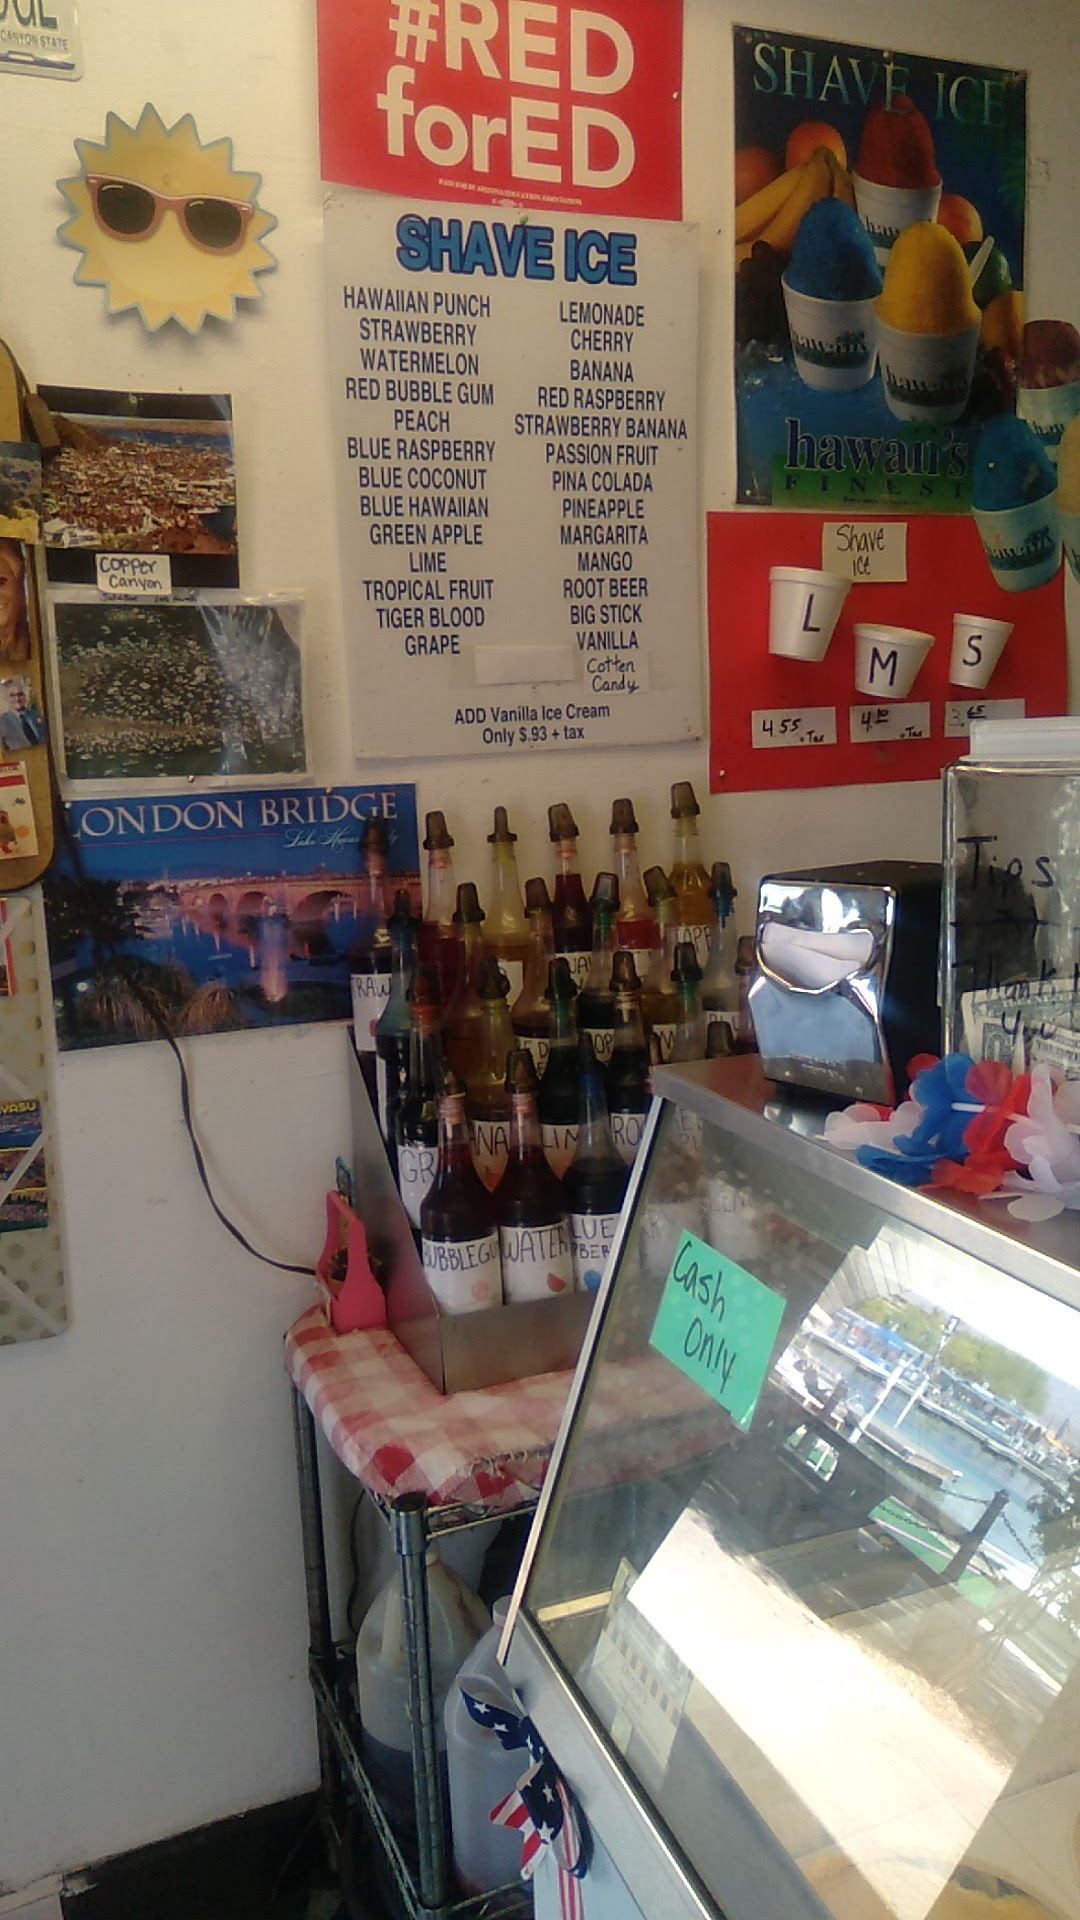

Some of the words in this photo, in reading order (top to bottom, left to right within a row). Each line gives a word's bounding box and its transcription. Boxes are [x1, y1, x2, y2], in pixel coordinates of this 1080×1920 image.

[40, 35, 68, 51] STATE
[389, 0, 634, 95] #RED
[753, 42, 910, 113] SHAVE
[935, 71, 1006, 126] ICE
[376, 65, 636, 189] forED
[396, 213, 554, 281] SHAVE
[564, 229, 638, 286] ICE
[343, 285, 428, 314] HAWAIIAN
[433, 291, 491, 318] PUNCH
[559, 301, 645, 327] LEMONADE
[359, 317, 477, 346] STRAWBERRY
[570, 329, 634, 353] CHERRY
[360, 348, 480, 376] WATERMELON
[569, 359, 634, 383] BANANA
[345, 377, 381, 400] RED
[385, 379, 452, 403] BUBBLE
[458, 382, 495, 406] GUM
[538, 386, 569, 408] RED
[573, 388, 666, 412] RASPBERRY
[394, 409, 451, 432] PEACH
[514, 414, 621, 439] STRAWBERRY
[625, 417, 688, 440] BANANA
[347, 437, 392, 460] BLUE
[398, 439, 496, 462] RASPBERRY
[545, 443, 613, 465] PASSION
[616, 445, 658, 466] FRUIT
[358, 467, 403, 488] BLUE
[407, 468, 488, 491] COCONUT
[552, 470, 587, 492] PINA
[591, 471, 654, 493] COLADA
[360, 496, 403, 517] BLUE
[408, 497, 489, 519] HAWAIIAN
[562, 498, 645, 520] PINEAPPLE
[369, 524, 427, 545] GREEN
[431, 524, 483, 545] APPLE
[560, 525, 649, 545] MARGARITA
[836, 524, 885, 552] Shave
[409, 552, 447, 573] LIME
[577, 551, 633, 571] MANGO
[108, 573, 163, 591] Canyon
[362, 579, 445, 601] TROPICAL
[449, 579, 494, 600] FRUIT
[563, 578, 605, 599] ROOT
[609, 577, 649, 598] BEER
[376, 608, 425, 629] TIGER
[429, 607, 485, 627] BLOOD
[570, 605, 596, 625] BIG
[599, 604, 643, 624] STICK
[802, 593, 821, 632] L
[404, 634, 460, 656] GRAPE
[576, 631, 639, 651] VANILLA
[962, 634, 983, 667] S
[586, 657, 636, 674] Cotten
[868, 647, 898, 687] M
[592, 675, 640, 693] Candy
[454, 708, 487, 725] ADD
[490, 706, 538, 723] Vanilla
[541, 705, 562, 720] Ice
[565, 703, 611, 719] Cream
[482, 728, 516, 746] Only
[518, 727, 547, 743] $.93
[551, 730, 560, 739] +
[562, 725, 585, 740] tax
[73, 800, 244, 838] ONDON
[260, 792, 398, 827] BRIDGE
[957, 834, 1054, 897] Tips
[673, 1240, 725, 1323] Cash
[684, 1318, 737, 1394] Only
